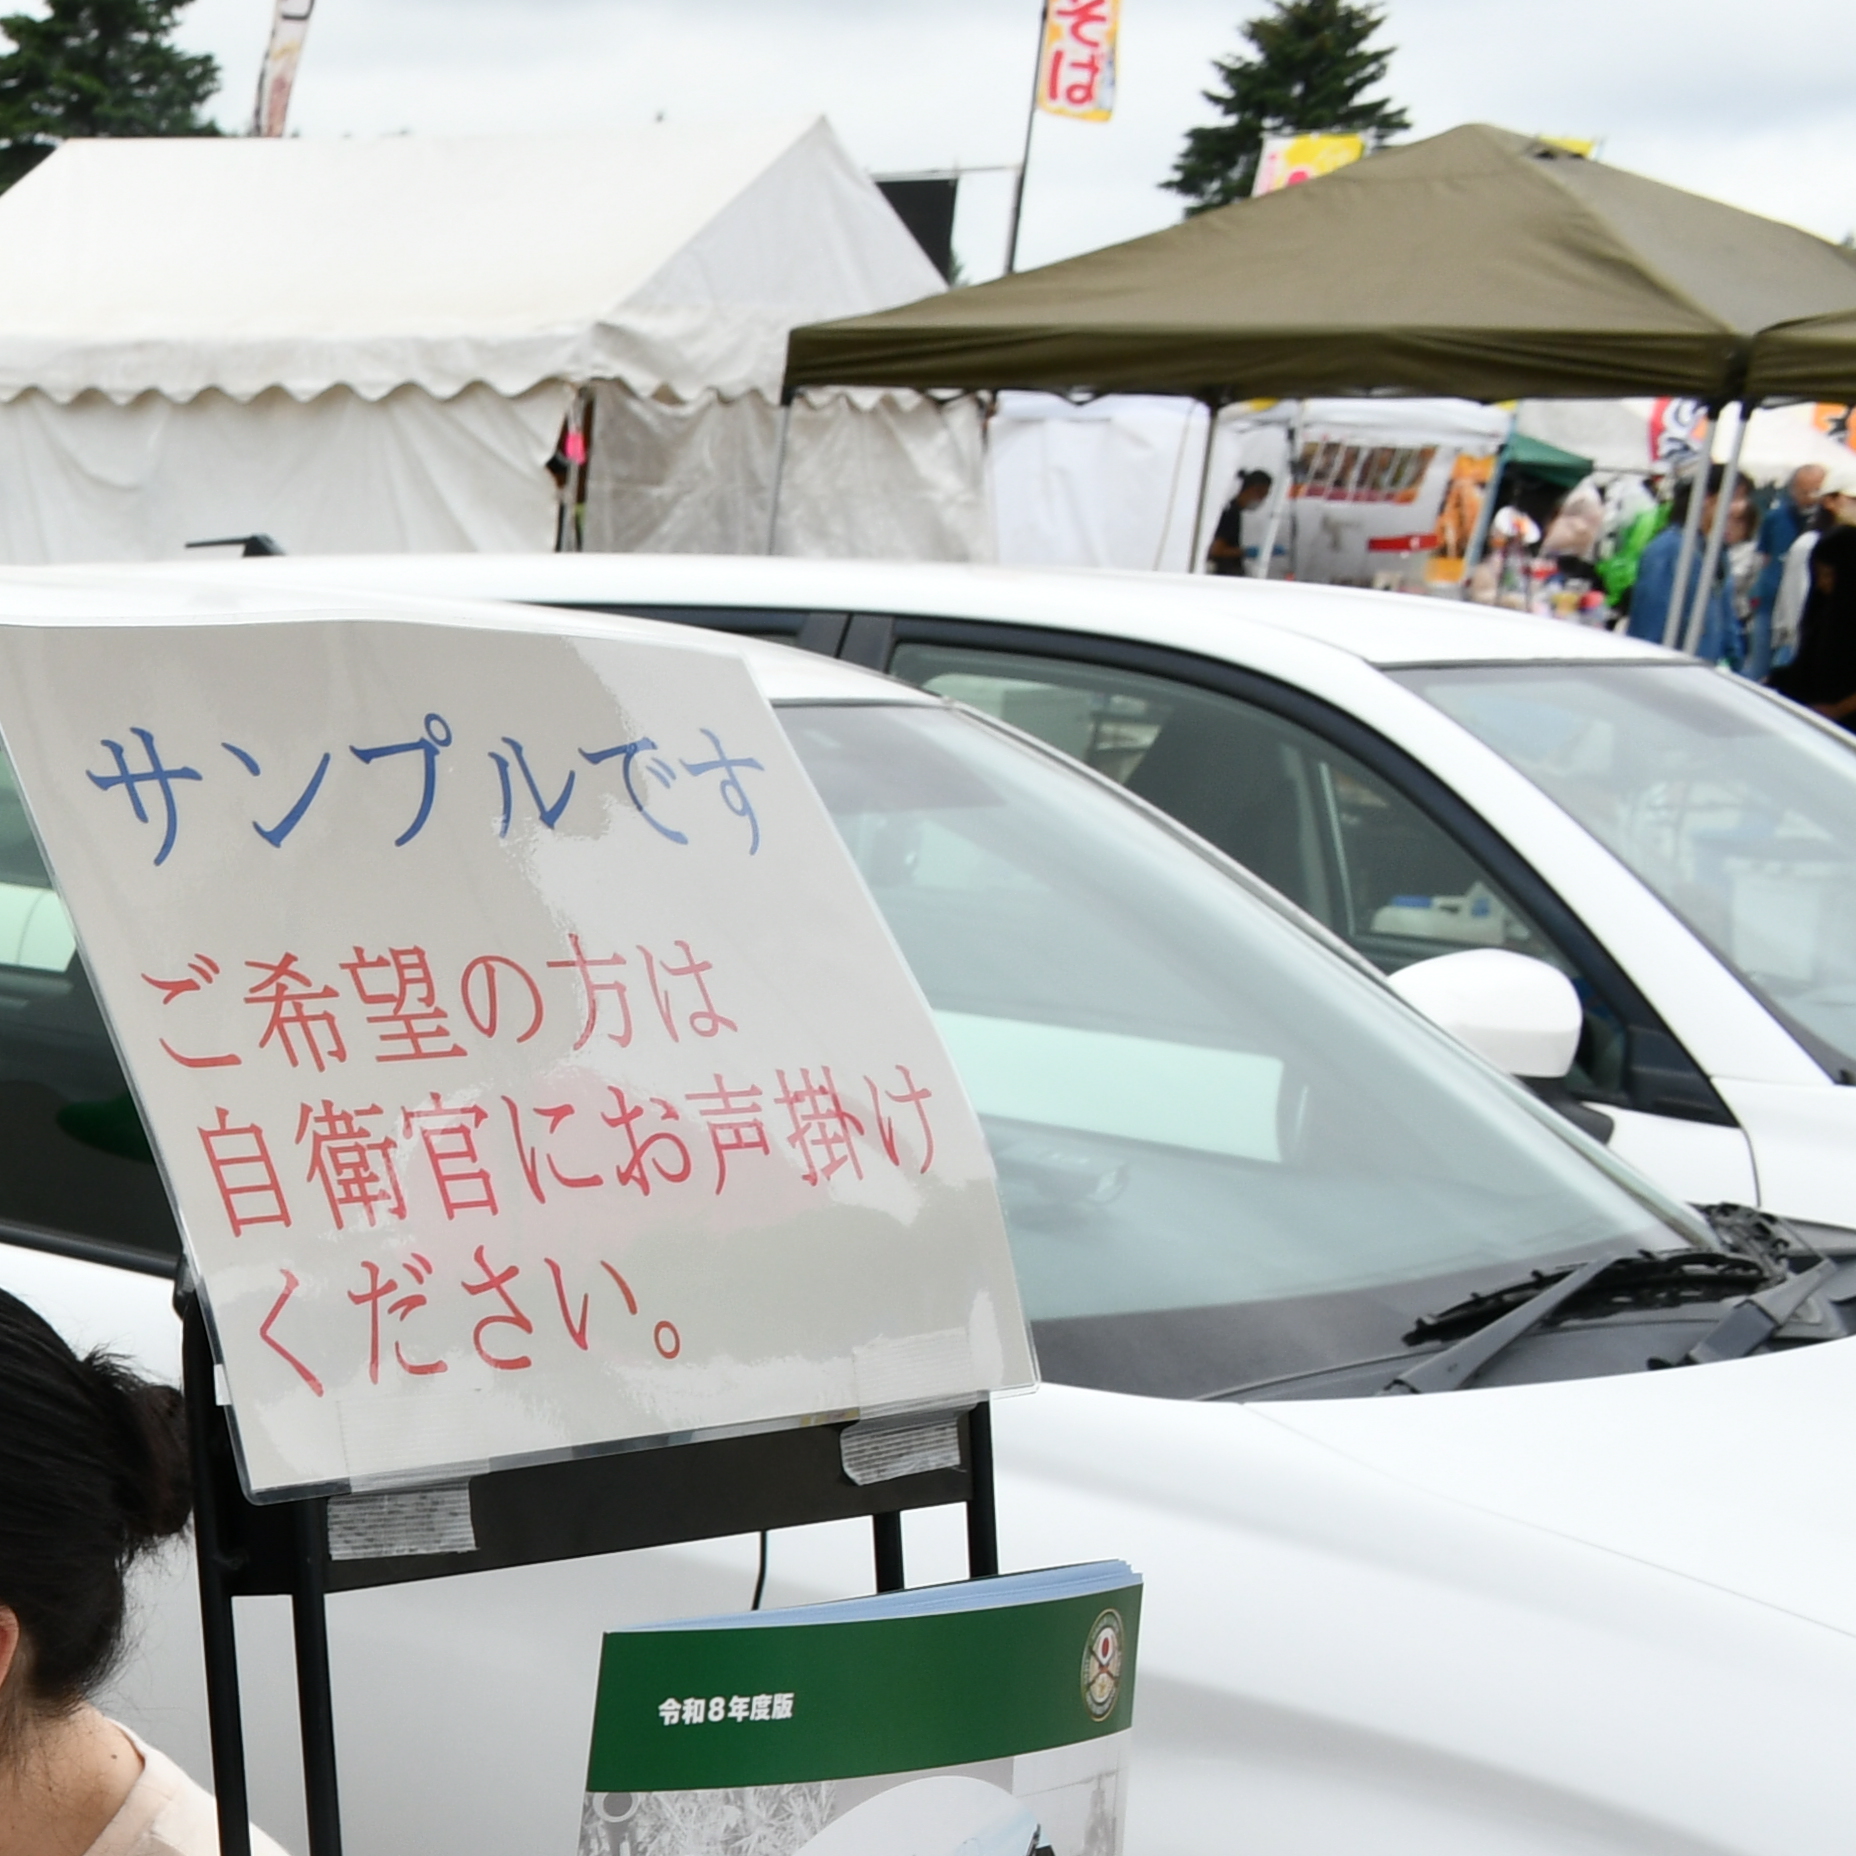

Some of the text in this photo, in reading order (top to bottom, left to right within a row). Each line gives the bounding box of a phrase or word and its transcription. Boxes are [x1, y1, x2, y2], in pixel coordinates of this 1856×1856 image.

[88, 713, 767, 866] サンプルです
[141, 932, 739, 1075] ご希望の方は
[197, 1063, 934, 1239] 自衛官にお声掛け
[258, 1245, 681, 1398] ください。
[657, 1692, 795, 1726] 令和8年度版
